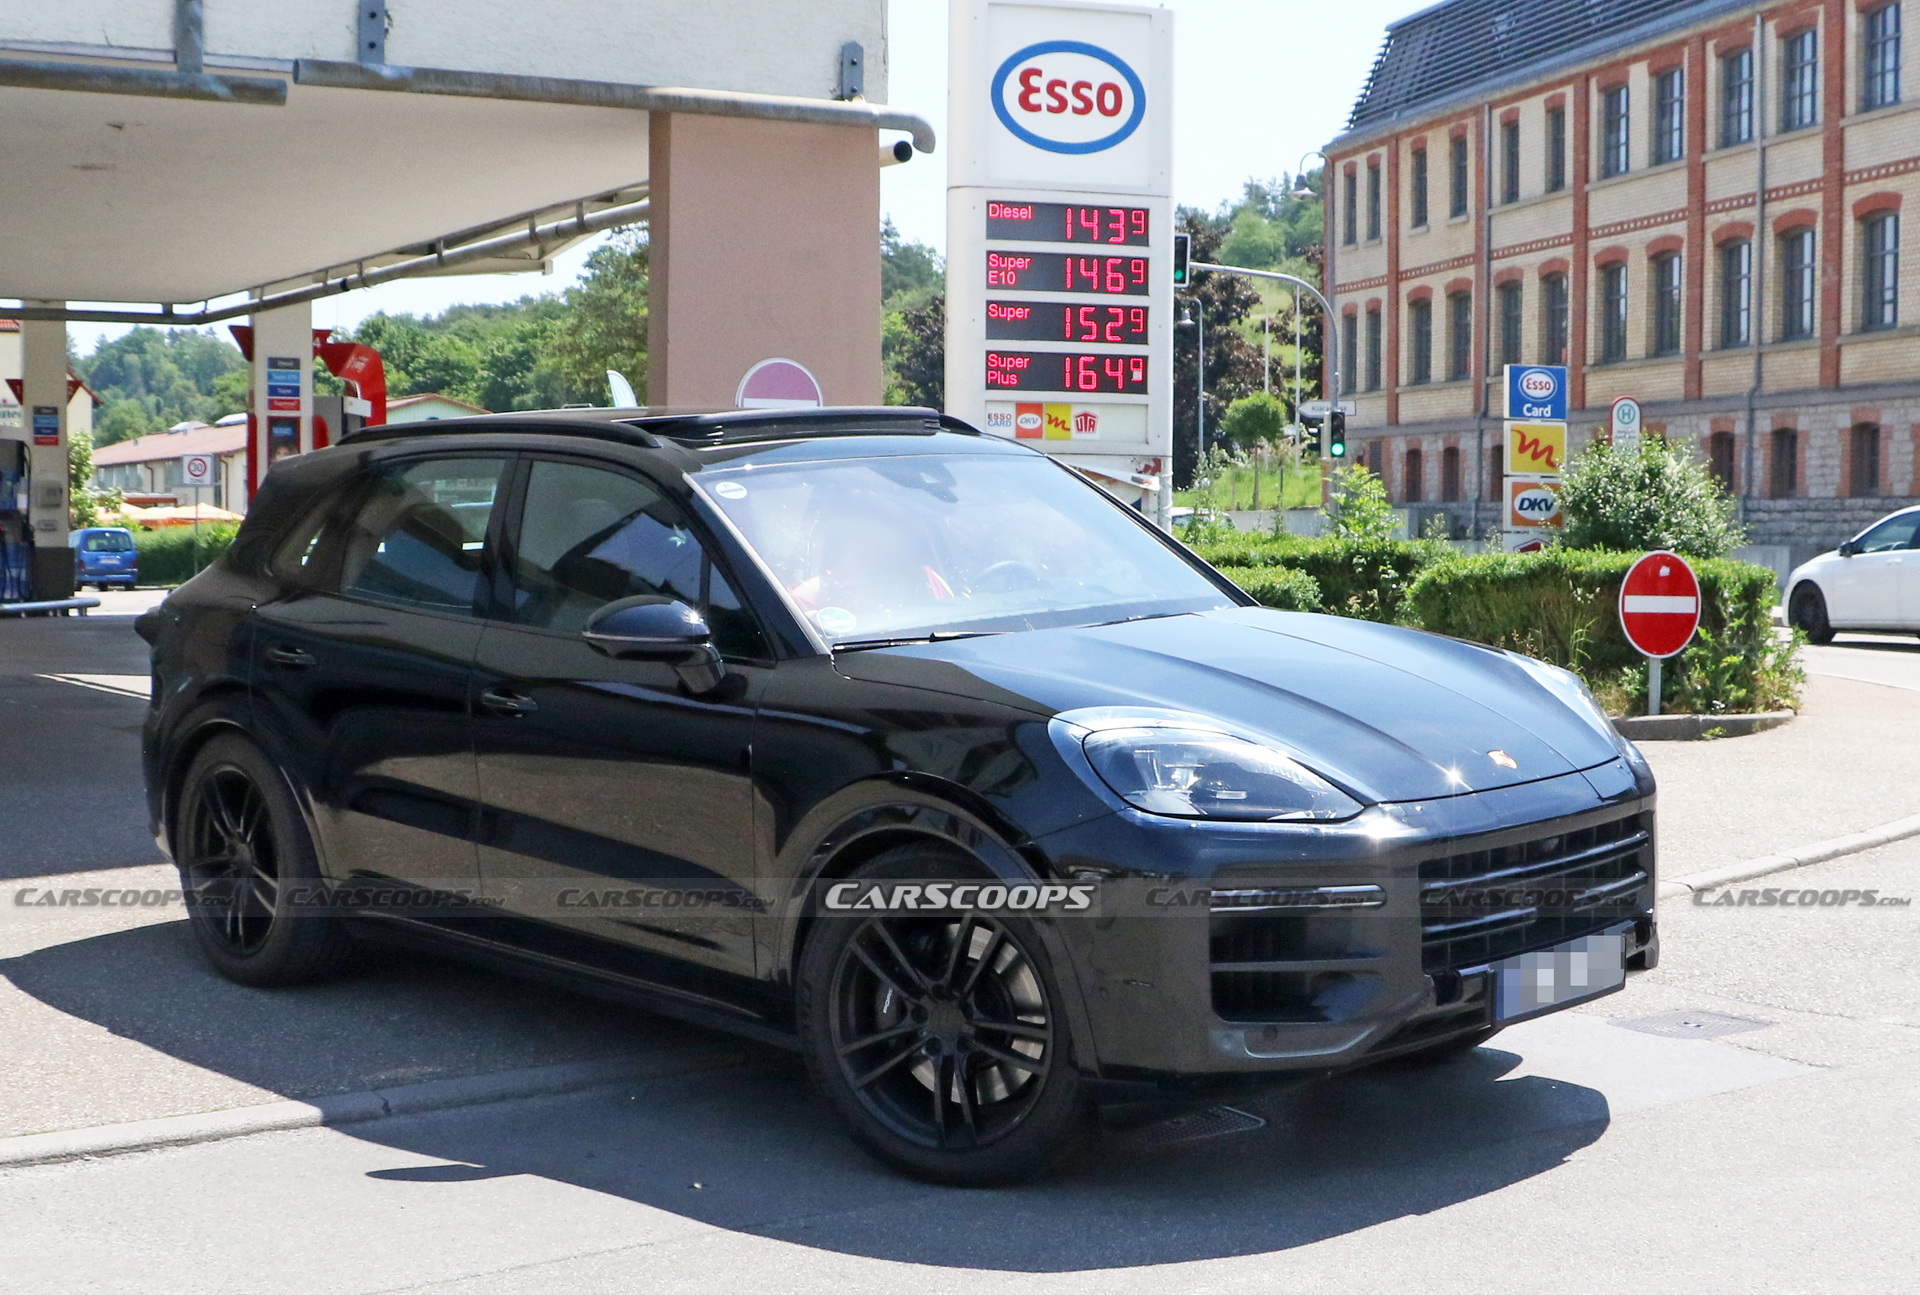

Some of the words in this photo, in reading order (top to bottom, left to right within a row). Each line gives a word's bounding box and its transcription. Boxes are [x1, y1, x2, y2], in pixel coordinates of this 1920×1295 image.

[1017, 67, 1122, 117] Esso
[988, 203, 1032, 220] Diesel
[988, 253, 1031, 270] Super
[988, 271, 1016, 286] E10
[988, 303, 1030, 321] Super
[987, 353, 1030, 371] Super
[987, 371, 1019, 386] Plus
[1525, 377, 1551, 391] Esso
[1522, 403, 1552, 418] Card
[1621, 408, 1631, 420] H
[1019, 417, 1039, 425] DKV
[191, 462, 203, 472] 30
[1517, 497, 1554, 512] DKV
